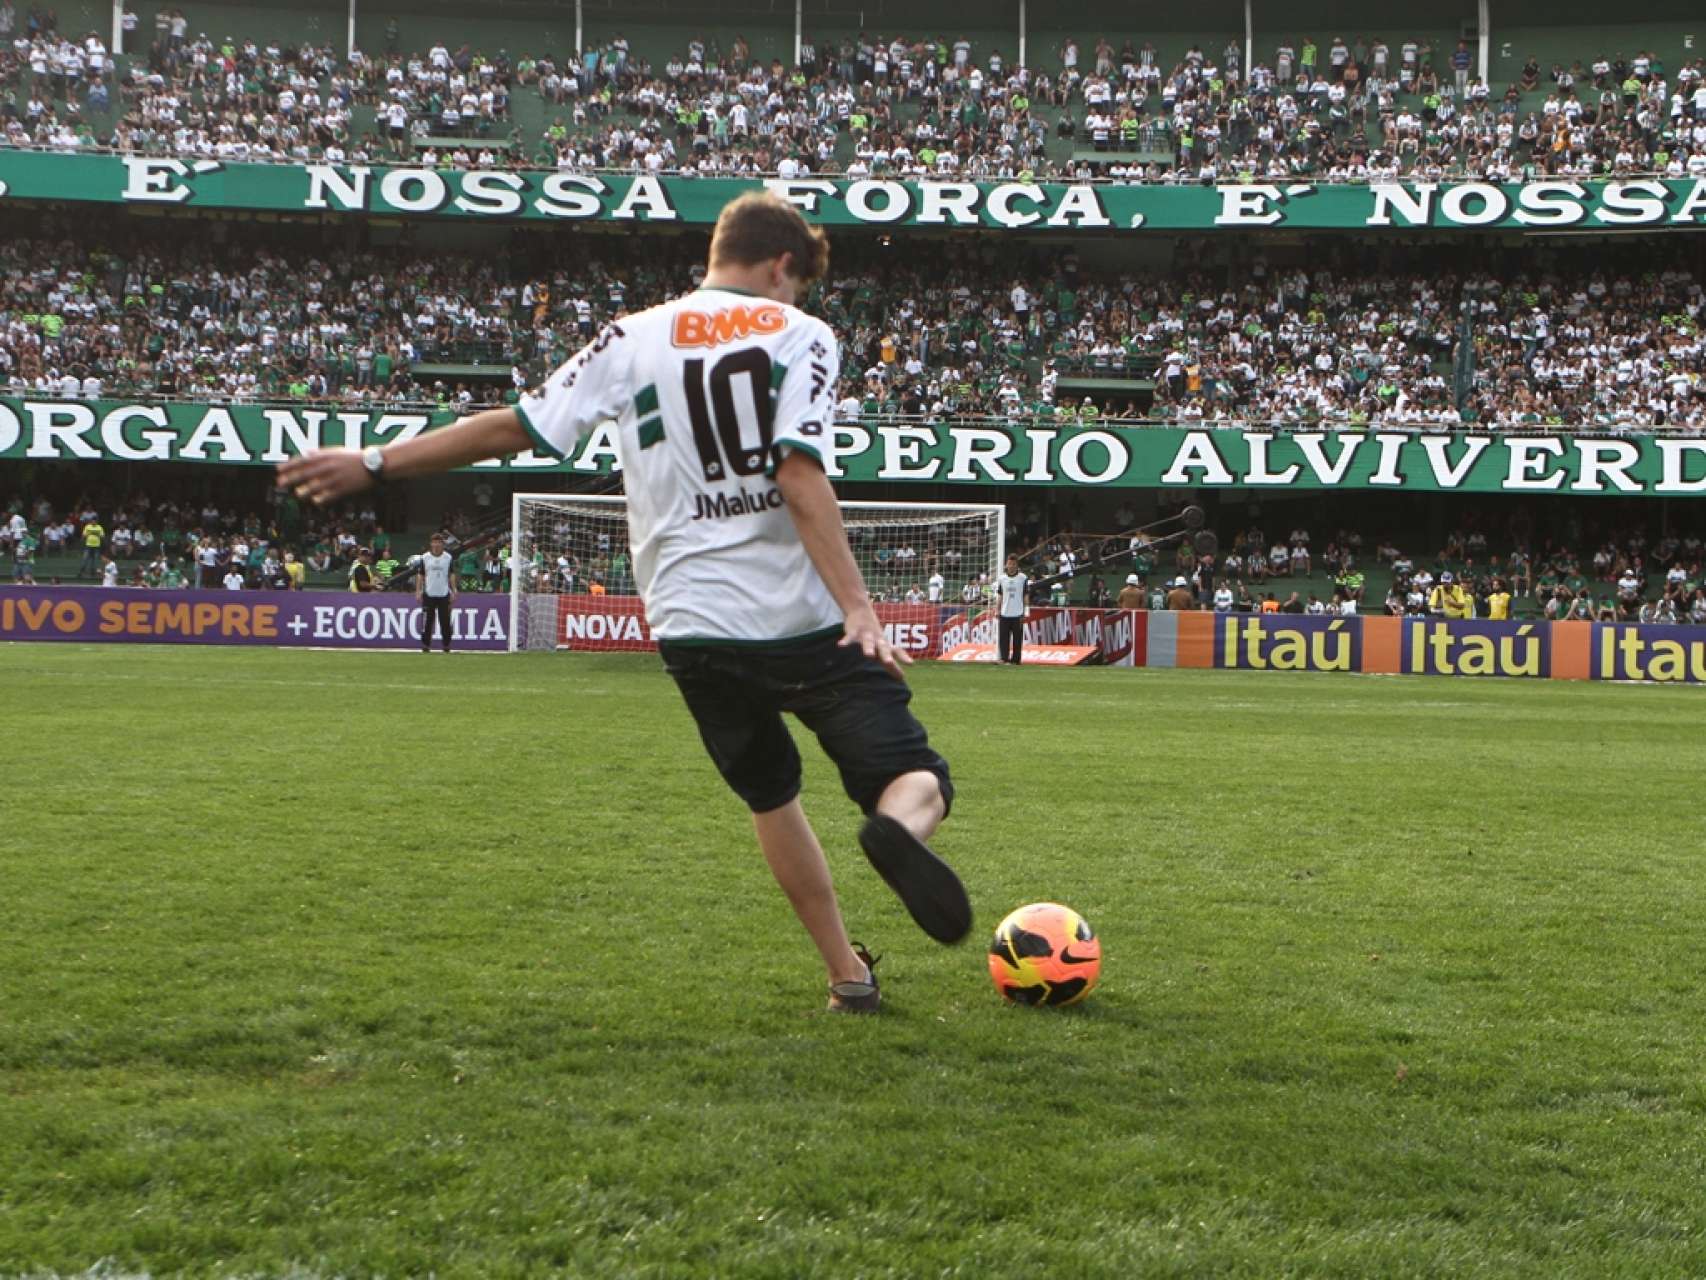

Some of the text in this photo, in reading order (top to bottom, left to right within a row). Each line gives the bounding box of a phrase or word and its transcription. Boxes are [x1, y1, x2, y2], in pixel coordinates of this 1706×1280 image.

[304, 165, 677, 219] NOSSA
[672, 305, 788, 348] BMG
[683, 346, 774, 482] 10
[99, 601, 279, 637] SEMPRE
[566, 614, 643, 641] NOVA
[1223, 616, 1351, 670] Itaú
[1411, 621, 1540, 677] Itaú
